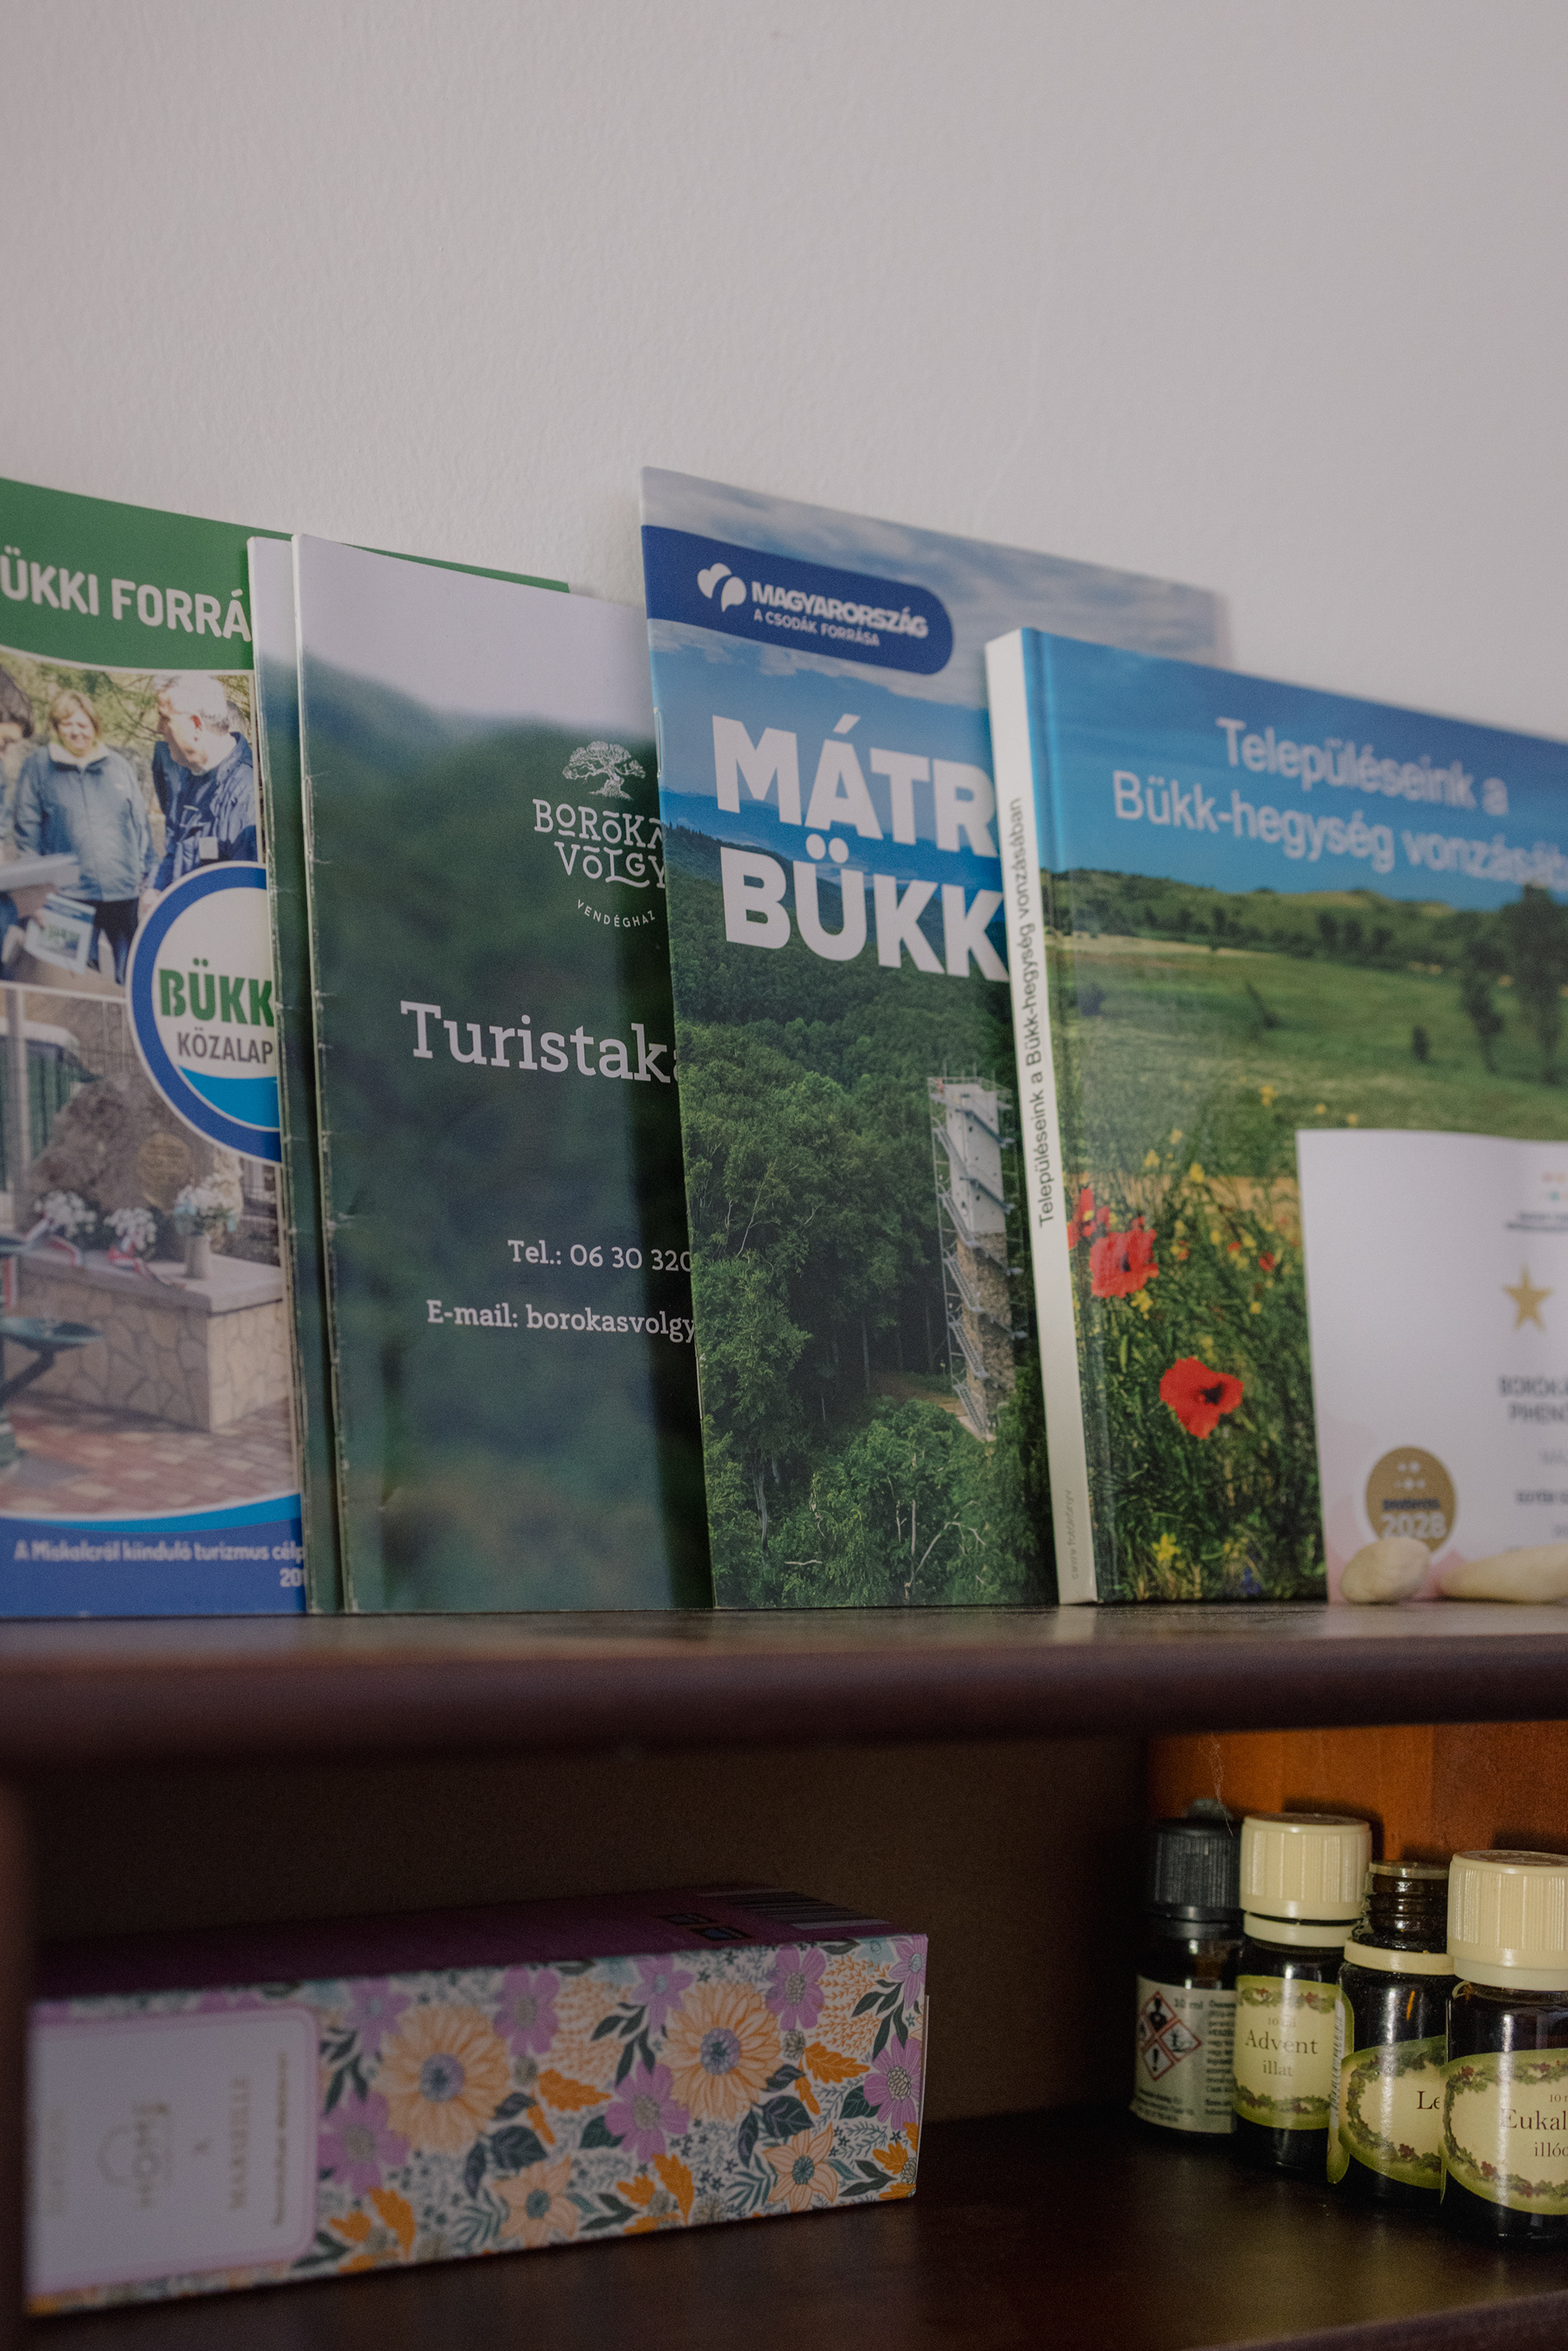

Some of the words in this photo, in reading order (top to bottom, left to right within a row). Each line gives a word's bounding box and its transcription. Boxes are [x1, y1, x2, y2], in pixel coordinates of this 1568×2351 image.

[111, 578, 252, 643] FORRÁ
[751, 581, 929, 639] MAGYARORSZÁG
[754, 608, 763, 621] A
[765, 611, 817, 634] CSODÁK
[821, 621, 880, 647] FORRÁSA
[712, 713, 998, 857] MÁTR
[1215, 716, 1477, 810] Településeink
[1482, 777, 1508, 816] a
[1112, 769, 1395, 874] Bükk-hegység
[1009, 798, 1031, 919] vonzásában
[720, 833, 1012, 983] BÜKK
[159, 958, 274, 1027] BÜKK
[1020, 923, 1042, 1066] Bükk-hegység
[177, 1027, 273, 1063] KÖZALAP
[400, 1000, 678, 1084] Turistak
[1031, 1071, 1044, 1084] a
[1030, 1089, 1055, 1228] Településeink
[507, 1240, 561, 1265] Tel.:
[570, 1244, 604, 1268] 06
[611, 1247, 643, 1270] 30
[426, 1299, 518, 1329] E-mail:
[526, 1304, 695, 1344] borokasvolgy
[194, 1541, 270, 1561] turizmus
[1245, 2029, 1319, 2054] Advent
[1263, 2059, 1294, 2077] illat
